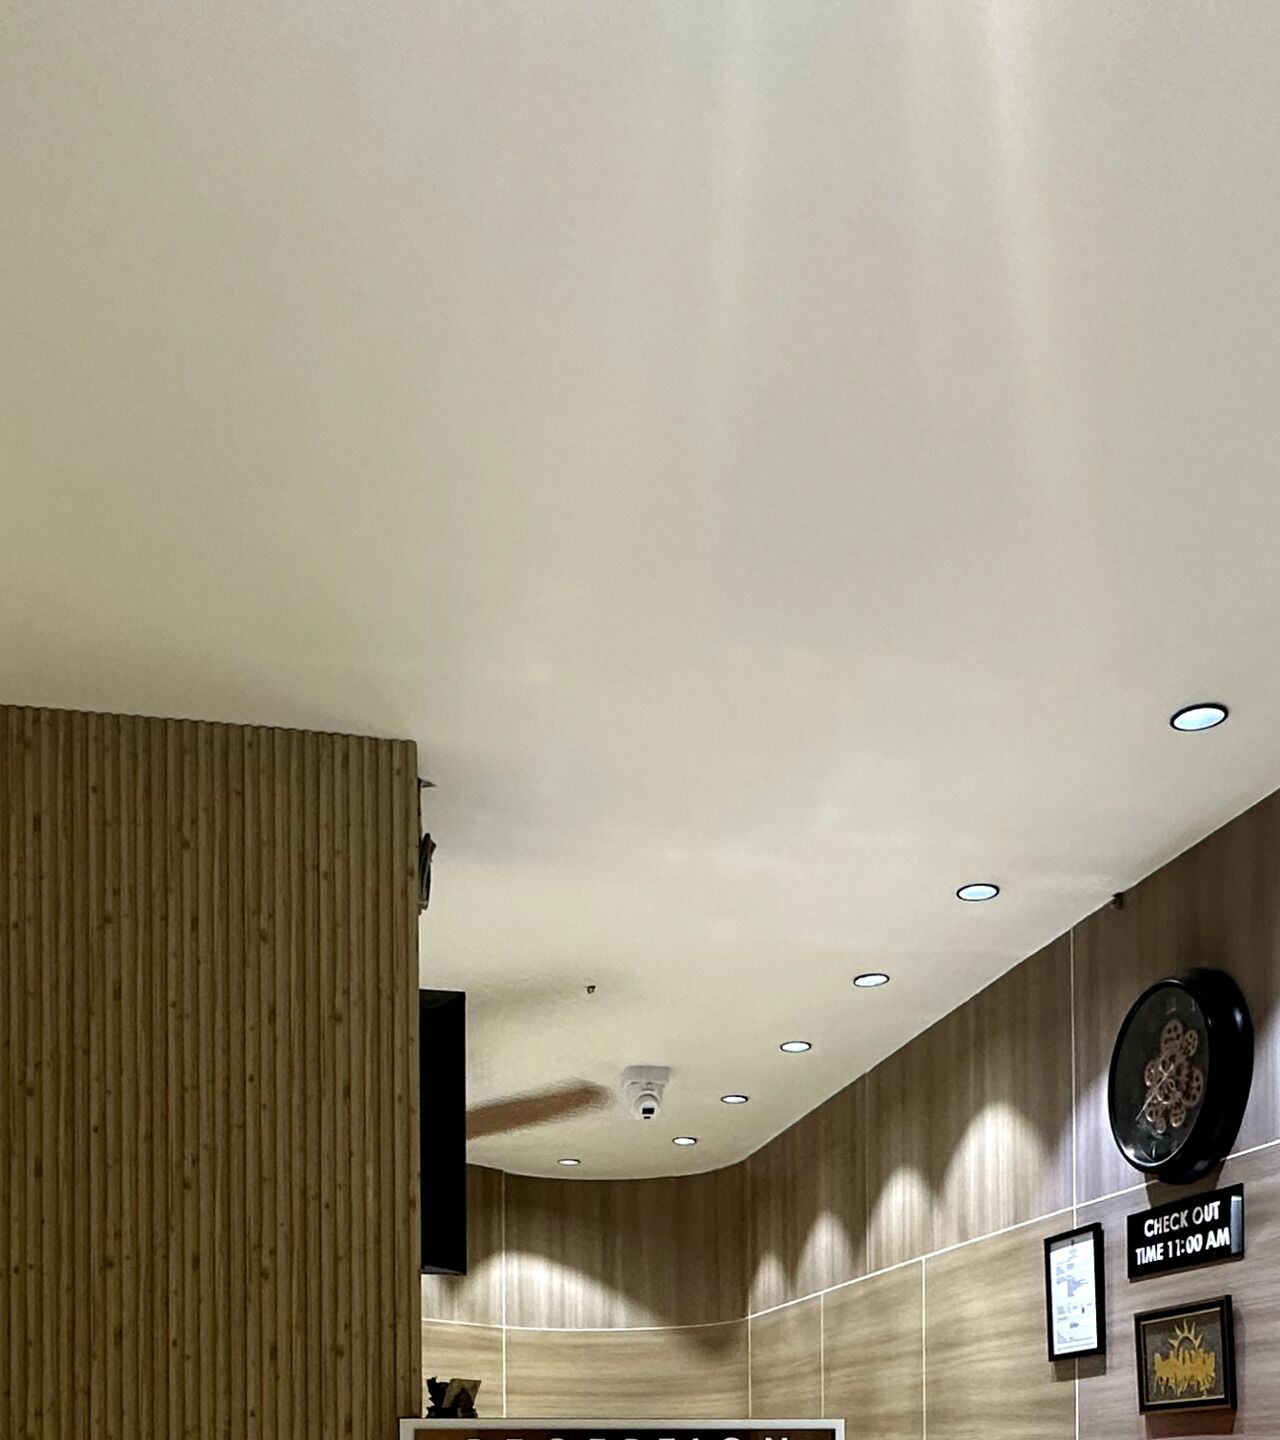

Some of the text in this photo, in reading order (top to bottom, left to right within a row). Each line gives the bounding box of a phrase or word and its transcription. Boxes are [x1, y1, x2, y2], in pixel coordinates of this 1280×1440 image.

[1144, 1201, 1221, 1237] CHECK OUT
[1136, 1227, 1230, 1265] TIME 11:00 AM
